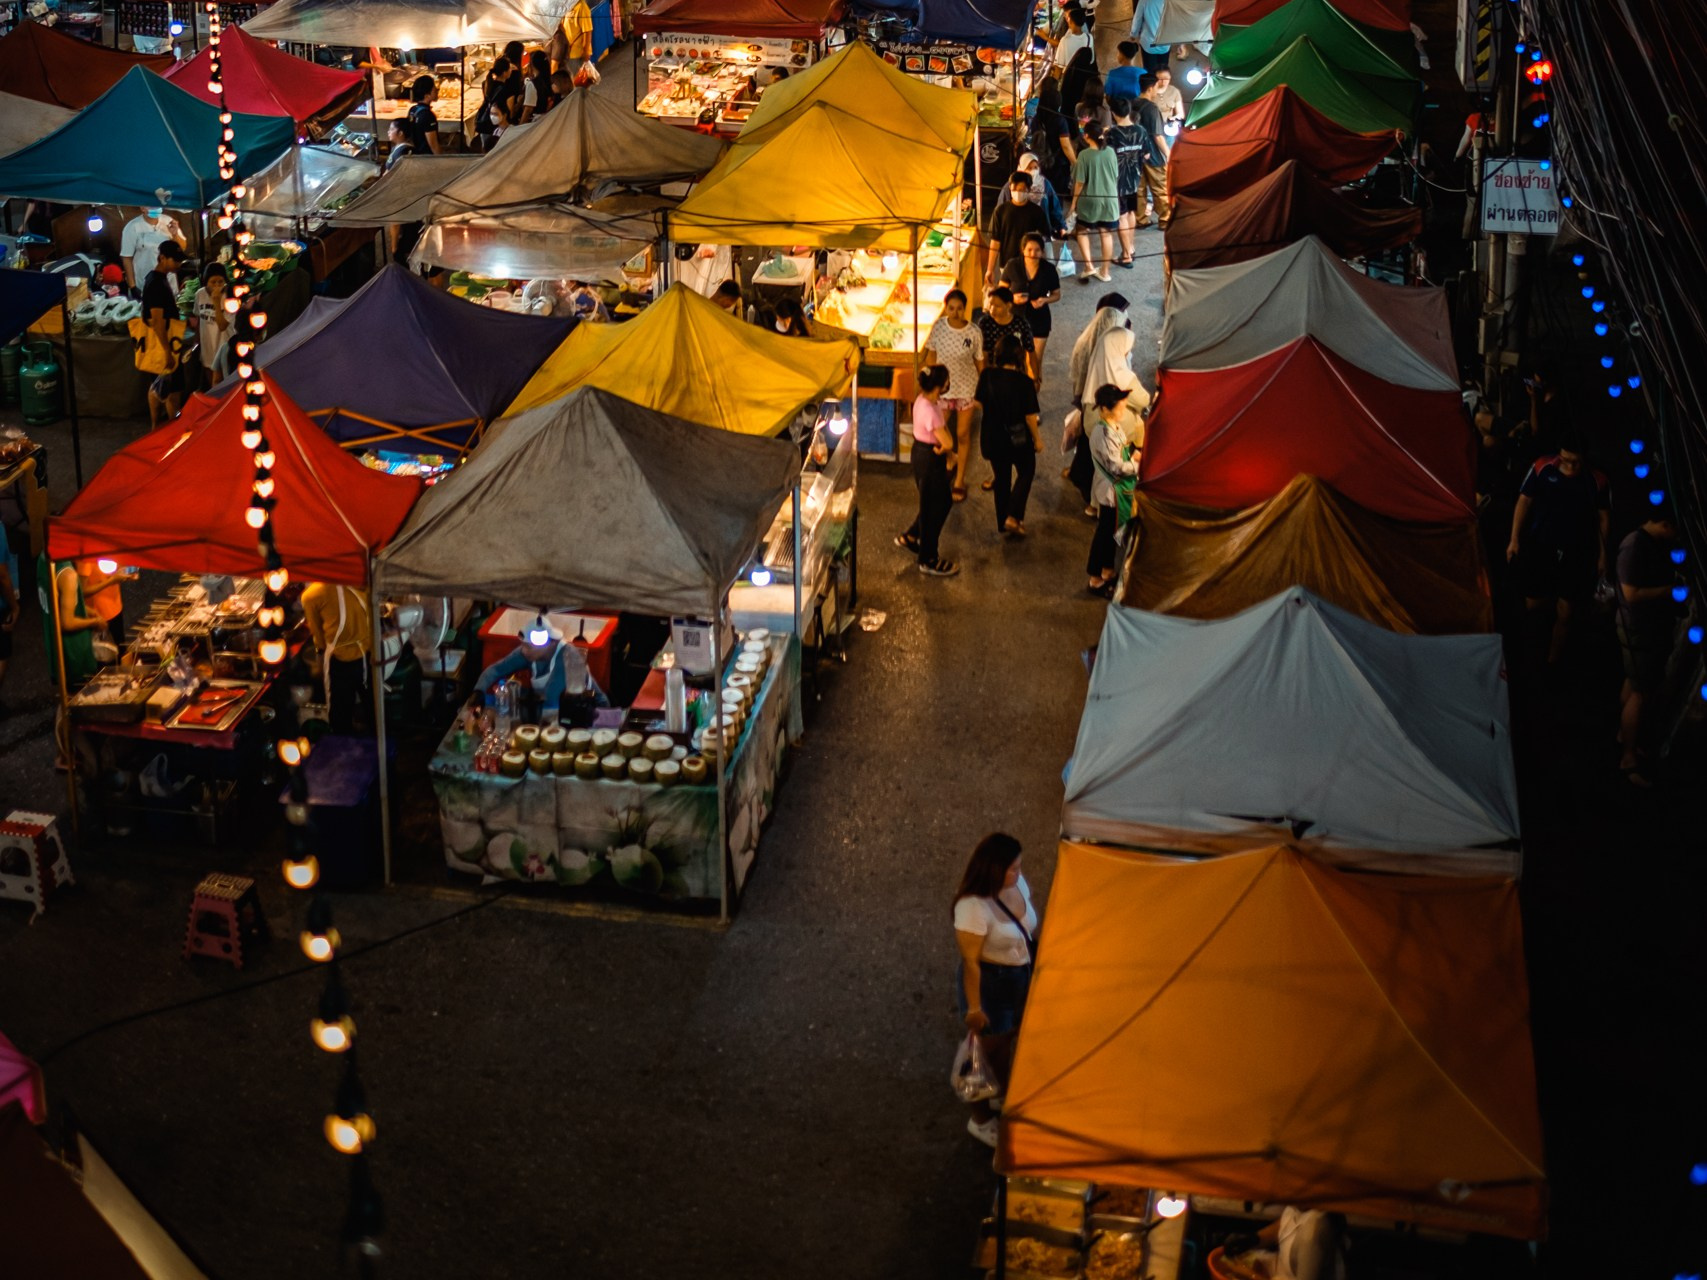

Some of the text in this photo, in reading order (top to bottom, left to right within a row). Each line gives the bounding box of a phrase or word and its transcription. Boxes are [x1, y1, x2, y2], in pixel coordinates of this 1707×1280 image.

[1494, 168, 1551, 190] ช่องซ้าย
[1486, 203, 1558, 223] ผ่านตลอด
